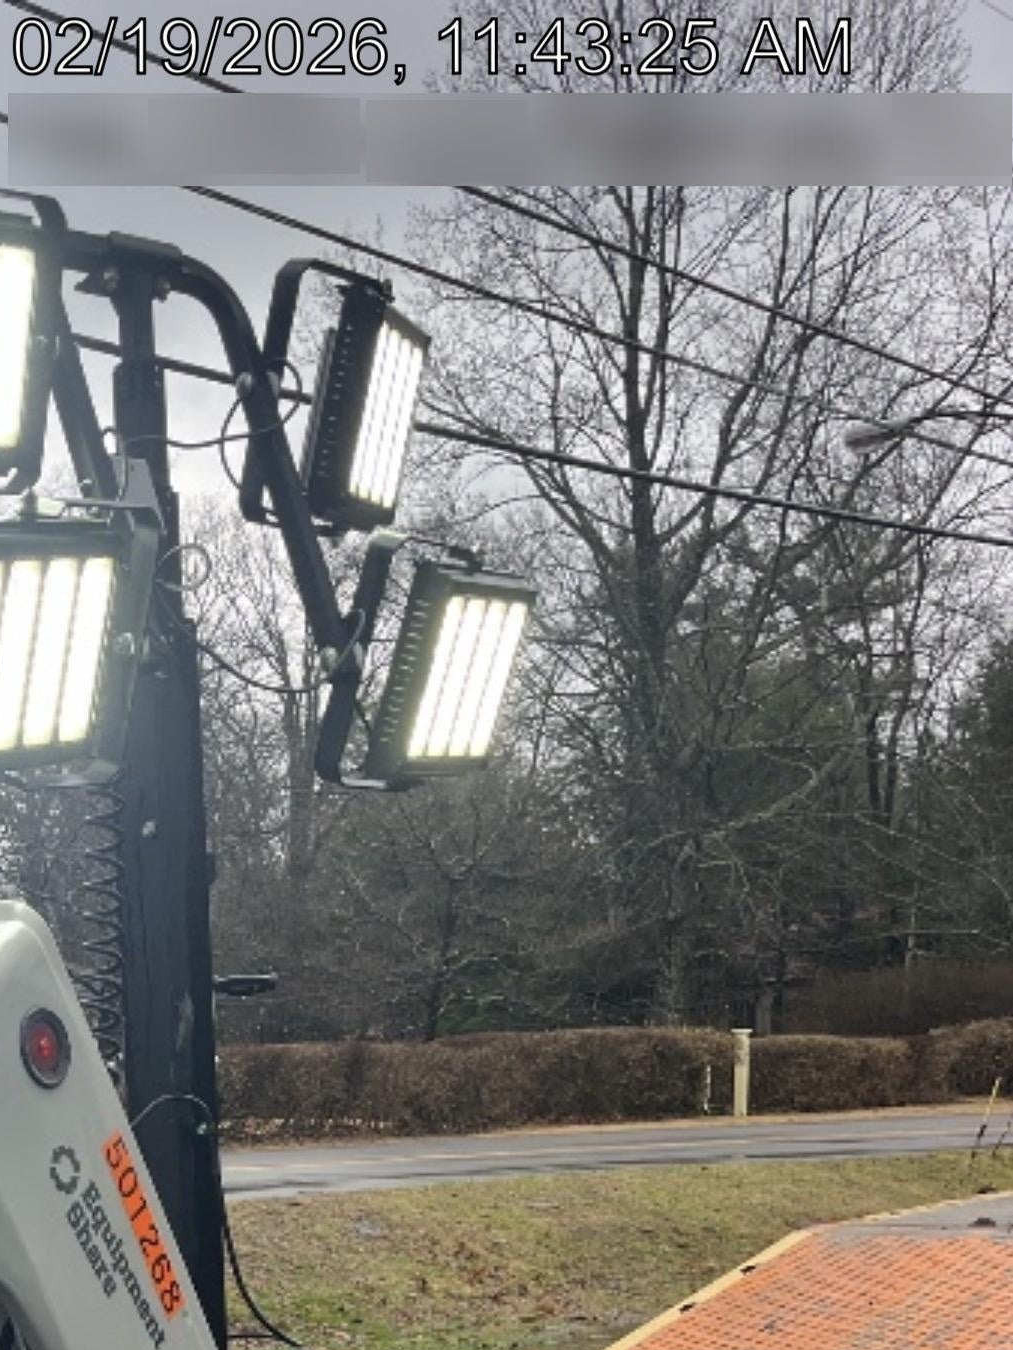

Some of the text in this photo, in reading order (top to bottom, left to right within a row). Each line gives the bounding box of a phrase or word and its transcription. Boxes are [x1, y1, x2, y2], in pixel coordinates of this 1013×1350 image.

[66, 1201, 117, 1299] Share
[80, 1179, 166, 1350] Equipment
[105, 1136, 181, 1314] 501268
